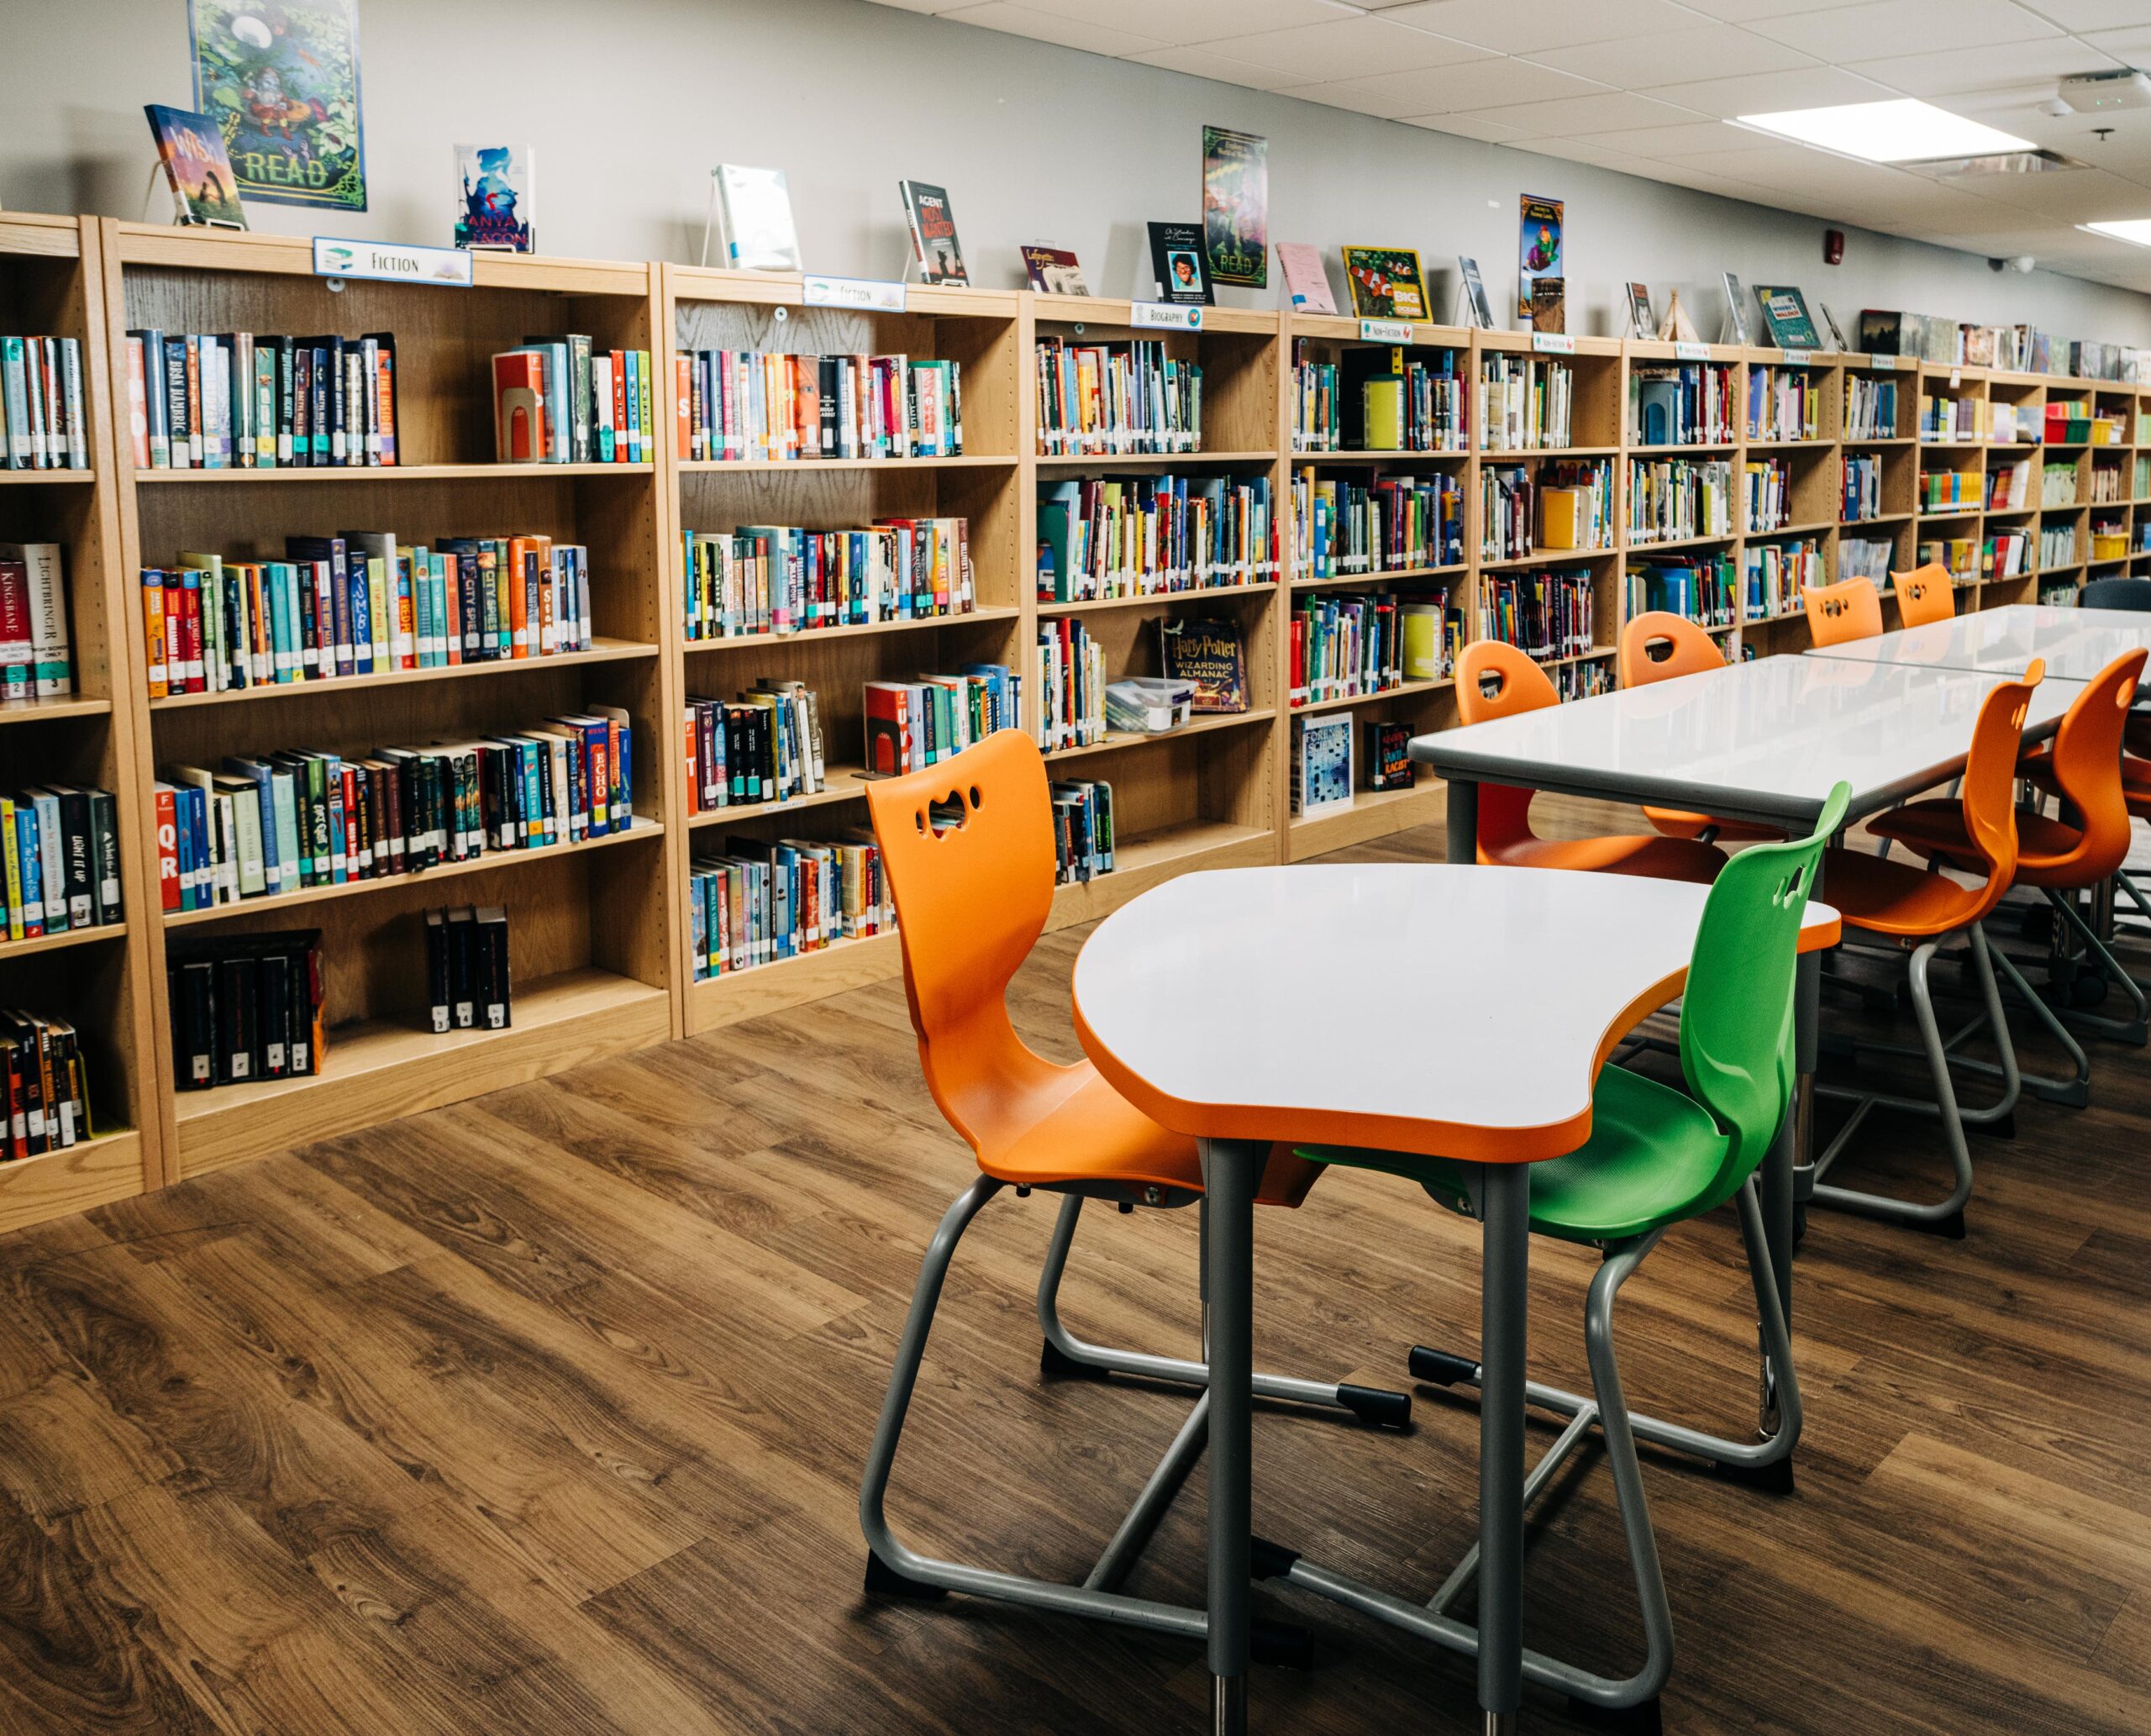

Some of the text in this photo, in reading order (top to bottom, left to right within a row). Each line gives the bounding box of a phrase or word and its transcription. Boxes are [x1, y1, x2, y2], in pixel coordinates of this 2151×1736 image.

[245, 153, 329, 187] READ
[469, 215, 515, 227] ANYA
[1220, 254, 1253, 275] READ
[1393, 290, 1420, 304] BIG
[170, 360, 185, 387] BRAN
[379, 374, 391, 393] THE
[678, 397, 690, 418] S
[960, 542, 969, 571] GULLIVER'S
[37, 556, 58, 639] LIGHTBRINGER
[465, 579, 476, 605] CITY
[486, 571, 497, 632] CITY SPIES
[789, 585, 797, 601] FOUL
[1, 572, 18, 634] KINGSBANE
[304, 592, 313, 614] THINGS
[192, 617, 201, 641] WORD
[1173, 634, 1237, 661] Harry Potter
[1175, 660, 1234, 671] WIZARDING
[1179, 669, 1230, 678] ALMANAC
[51, 677, 60, 689] 3
[898, 708, 907, 725] U
[899, 734, 907, 748] V
[1306, 723, 1349, 742] FORENSIC
[812, 737, 821, 750] TOM
[596, 753, 607, 798] ECHO
[686, 757, 697, 777] T
[1385, 758, 1409, 774] RACIST
[529, 776, 538, 799] NIKKI
[160, 795, 171, 807] F
[158, 823, 176, 851] Q
[72, 835, 87, 883] LIGHT IT UP
[160, 856, 178, 880] R
[438, 1021, 444, 1029] 3
[463, 1014, 469, 1023] 4
[494, 1015, 501, 1024] 5
